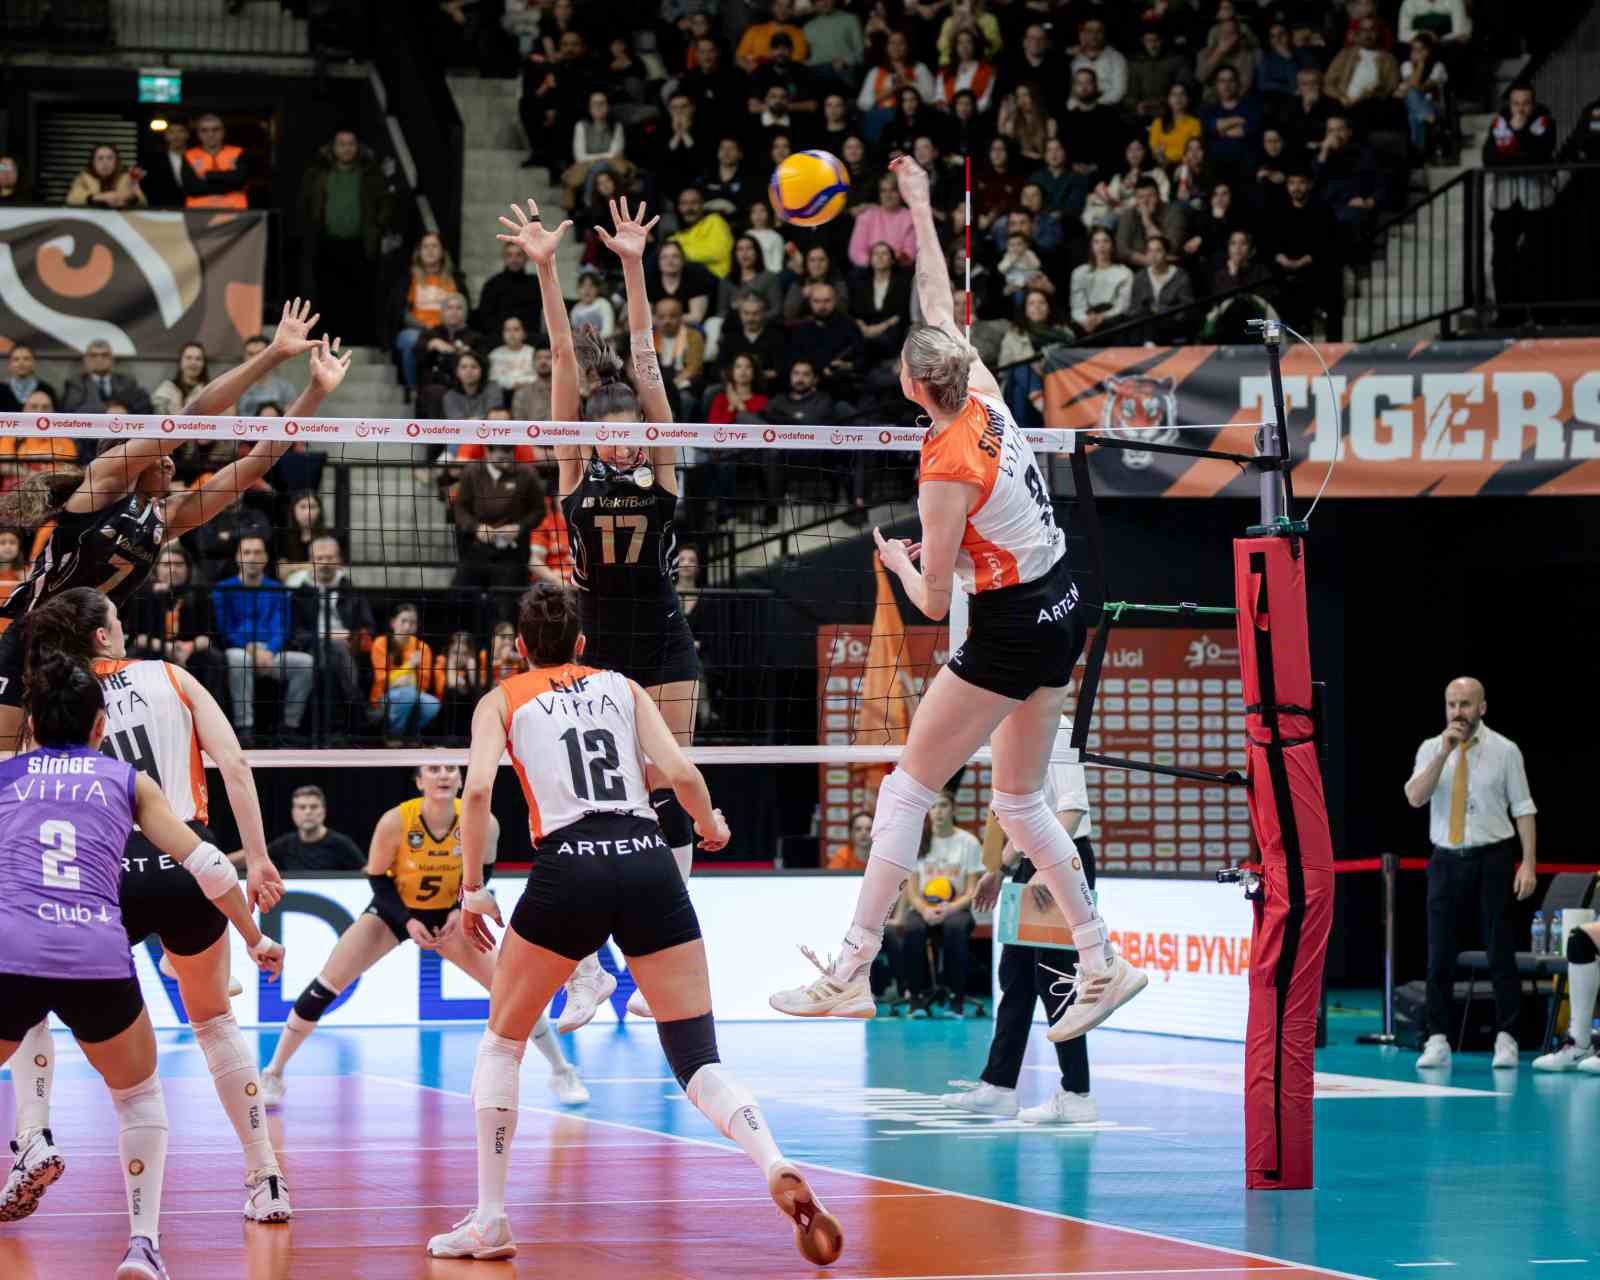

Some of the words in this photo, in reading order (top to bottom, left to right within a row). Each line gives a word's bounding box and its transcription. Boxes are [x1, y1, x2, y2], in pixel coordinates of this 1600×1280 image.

[52, 420, 92, 429] vodafone
[124, 423, 144, 432] TVF
[177, 422, 216, 431] vodafone
[249, 425, 268, 433] TVF
[300, 424, 339, 433] vodafone
[371, 426, 391, 435] TVF
[422, 426, 460, 435] vodafone
[492, 428, 511, 437] TVF
[542, 427, 581, 437] vodafone
[611, 430, 630, 439] TVF
[660, 429, 698, 438] vodafone
[728, 432, 748, 441] TVF
[778, 431, 815, 441] vodafone
[844, 434, 864, 443] TVF
[594, 514, 649, 564] 17
[92, 552, 136, 594] 7
[560, 727, 628, 801] 12
[39, 819, 81, 890] 2
[415, 875, 443, 902] 5
[37, 902, 92, 922] Club
